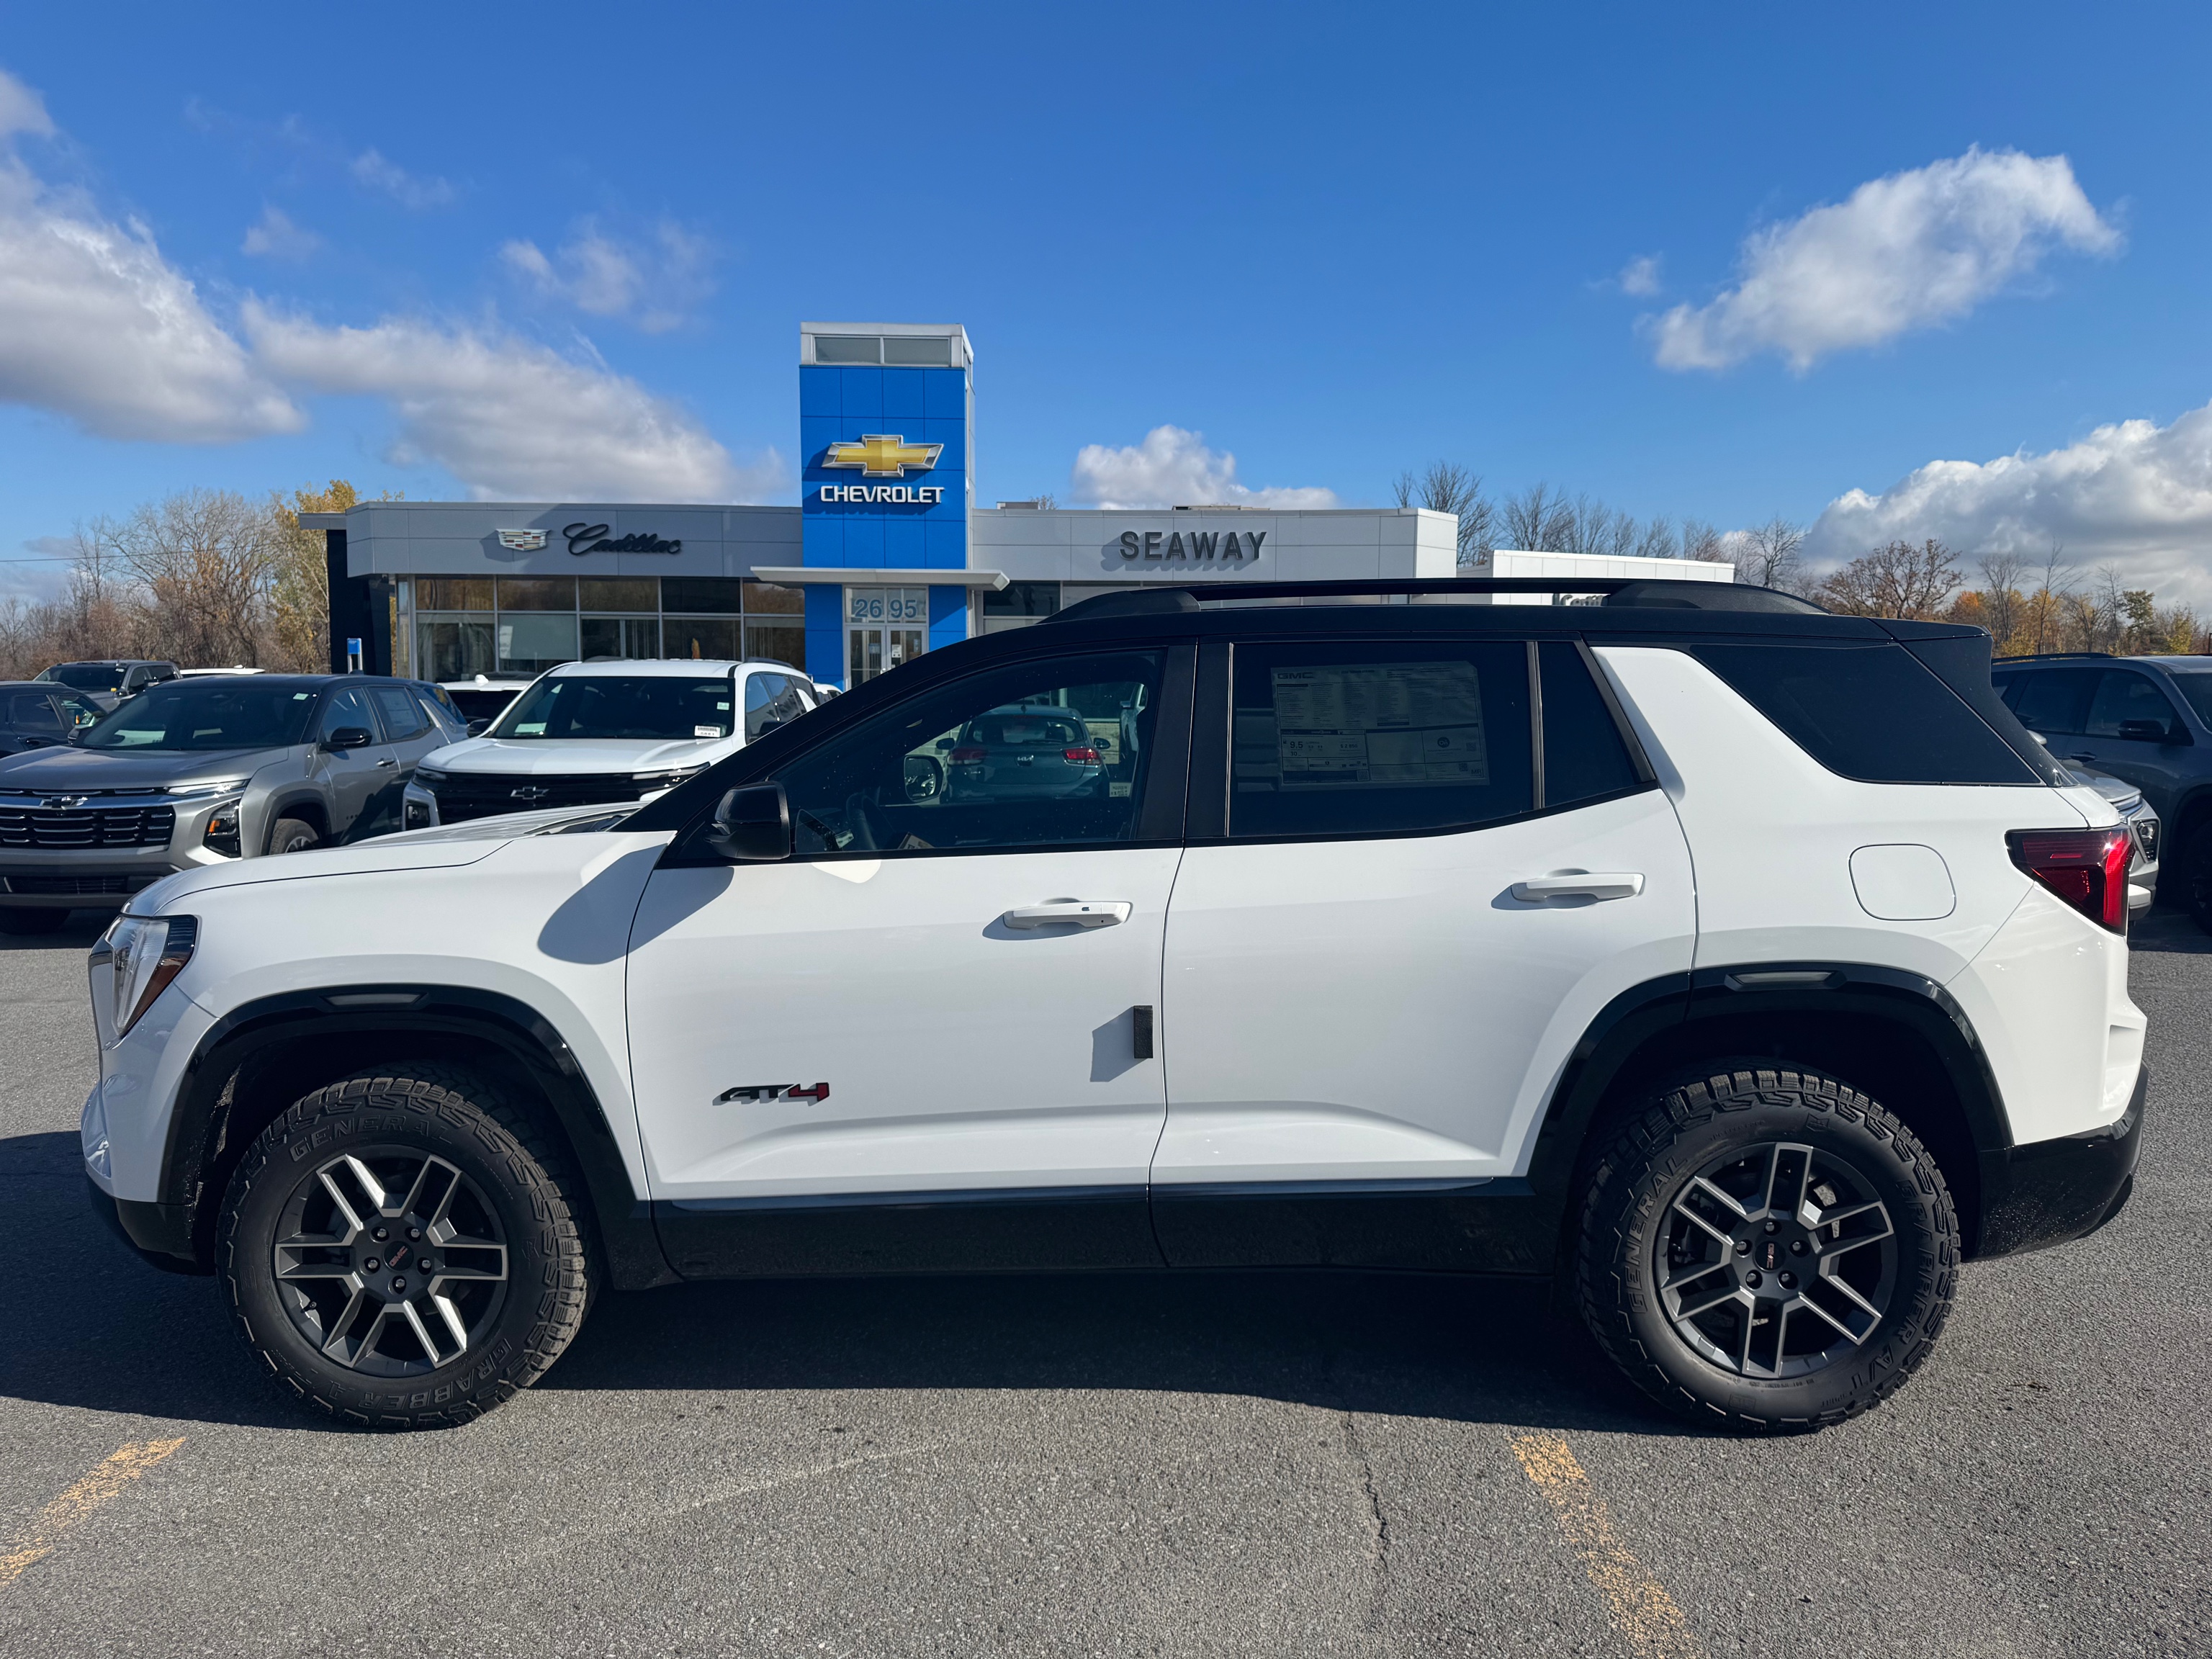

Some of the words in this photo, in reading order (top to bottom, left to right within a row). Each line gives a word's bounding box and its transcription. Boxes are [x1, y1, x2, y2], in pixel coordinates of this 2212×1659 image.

[820, 485, 945, 504] CHEVROLET
[562, 522, 682, 556] Cadillac
[1120, 531, 1267, 560] SEAWAY
[720, 1082, 830, 1102] AT4
[290, 1115, 452, 1162] GENERAL
[1624, 1156, 1688, 1313] GENERAL
[1895, 1179, 1935, 1344] GRABBER
[358, 1338, 513, 1411] GRABBER
